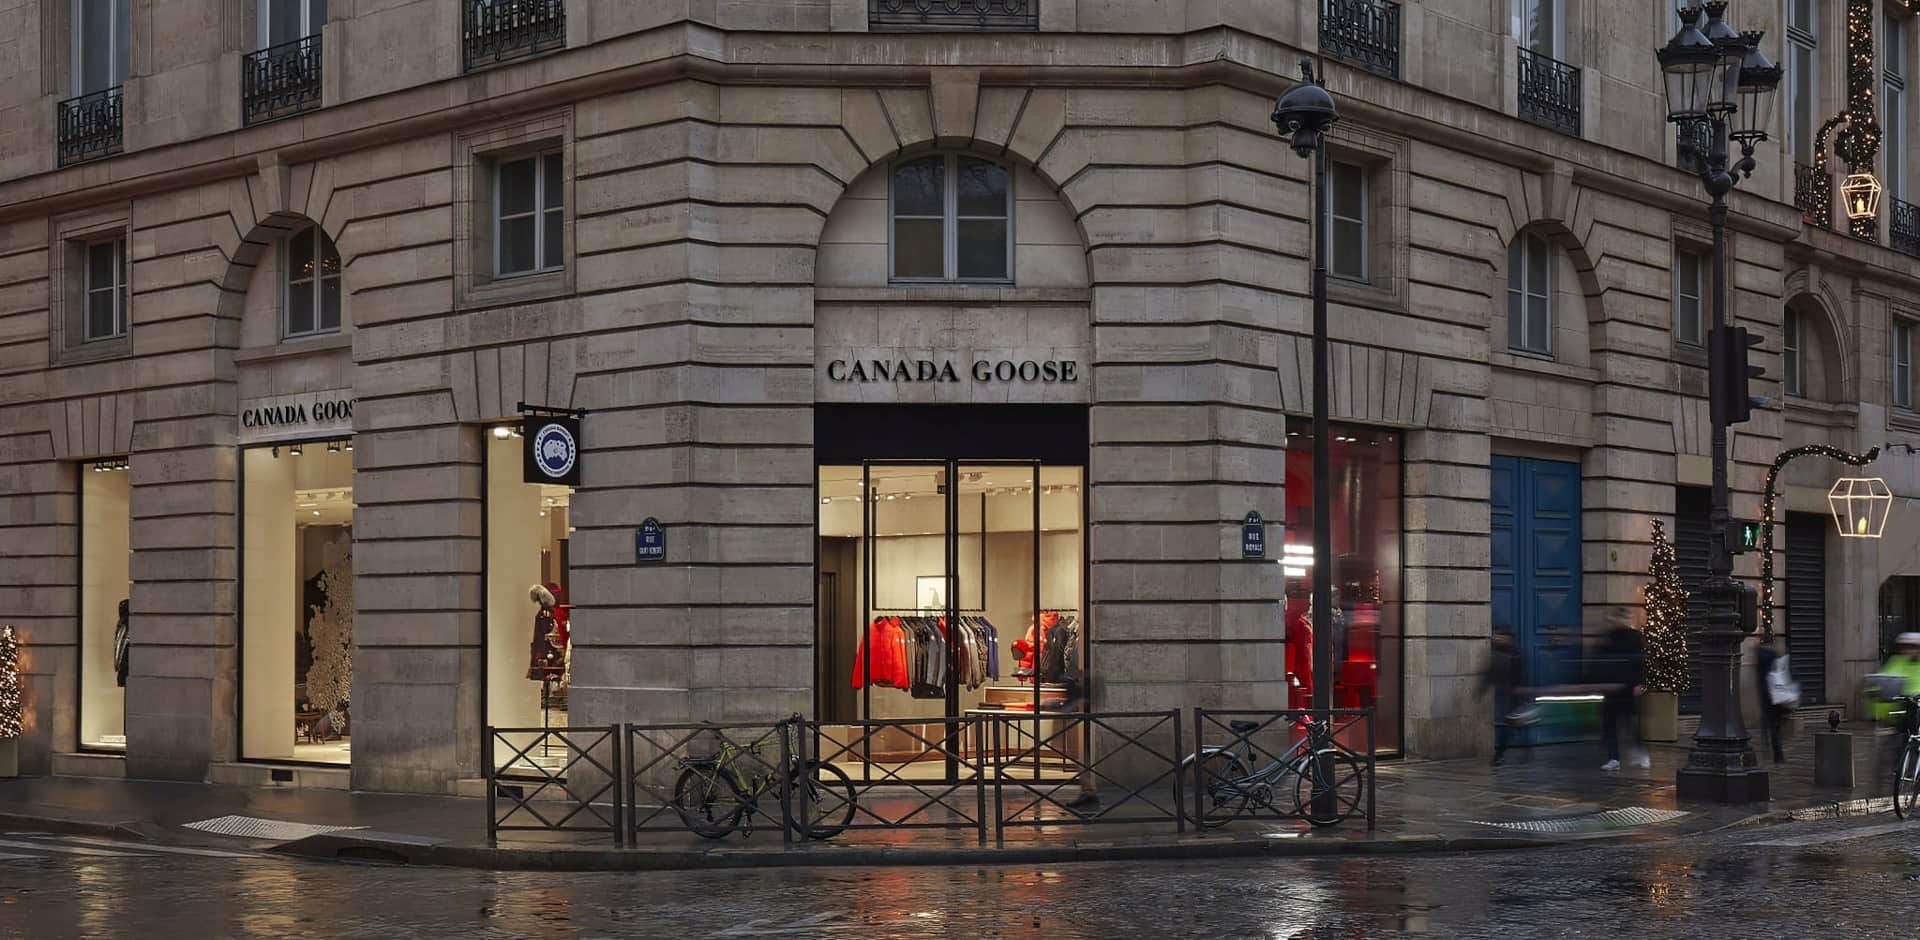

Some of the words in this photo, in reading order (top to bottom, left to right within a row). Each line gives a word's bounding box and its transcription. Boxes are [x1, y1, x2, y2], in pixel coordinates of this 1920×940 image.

[827, 360, 959, 382] CANADA
[972, 360, 1078, 382] GOOSE
[242, 404, 307, 428] CANADA
